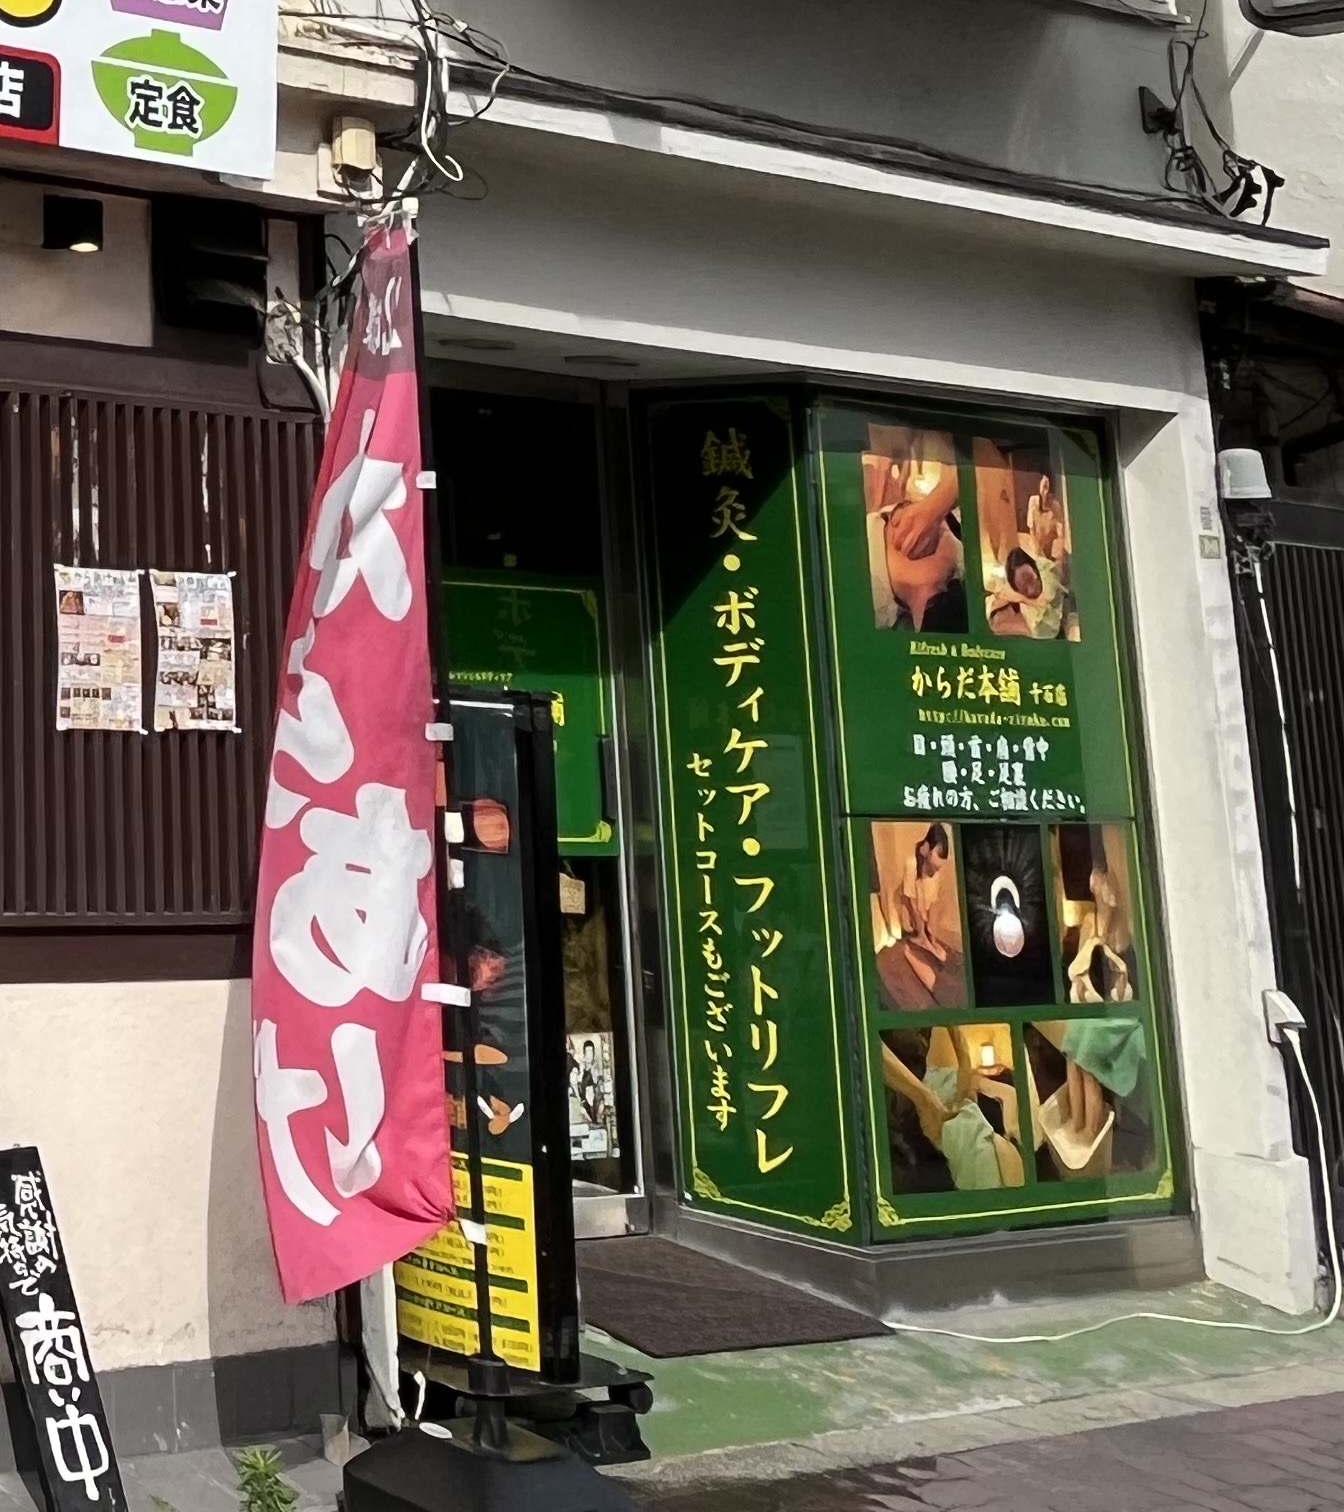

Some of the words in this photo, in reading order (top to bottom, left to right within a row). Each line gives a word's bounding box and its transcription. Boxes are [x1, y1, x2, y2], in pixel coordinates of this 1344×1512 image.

[128, 78, 202, 133] 定食
[686, 752, 737, 1133] セットコースもございます
[14, 1292, 110, 1502] 商い中
